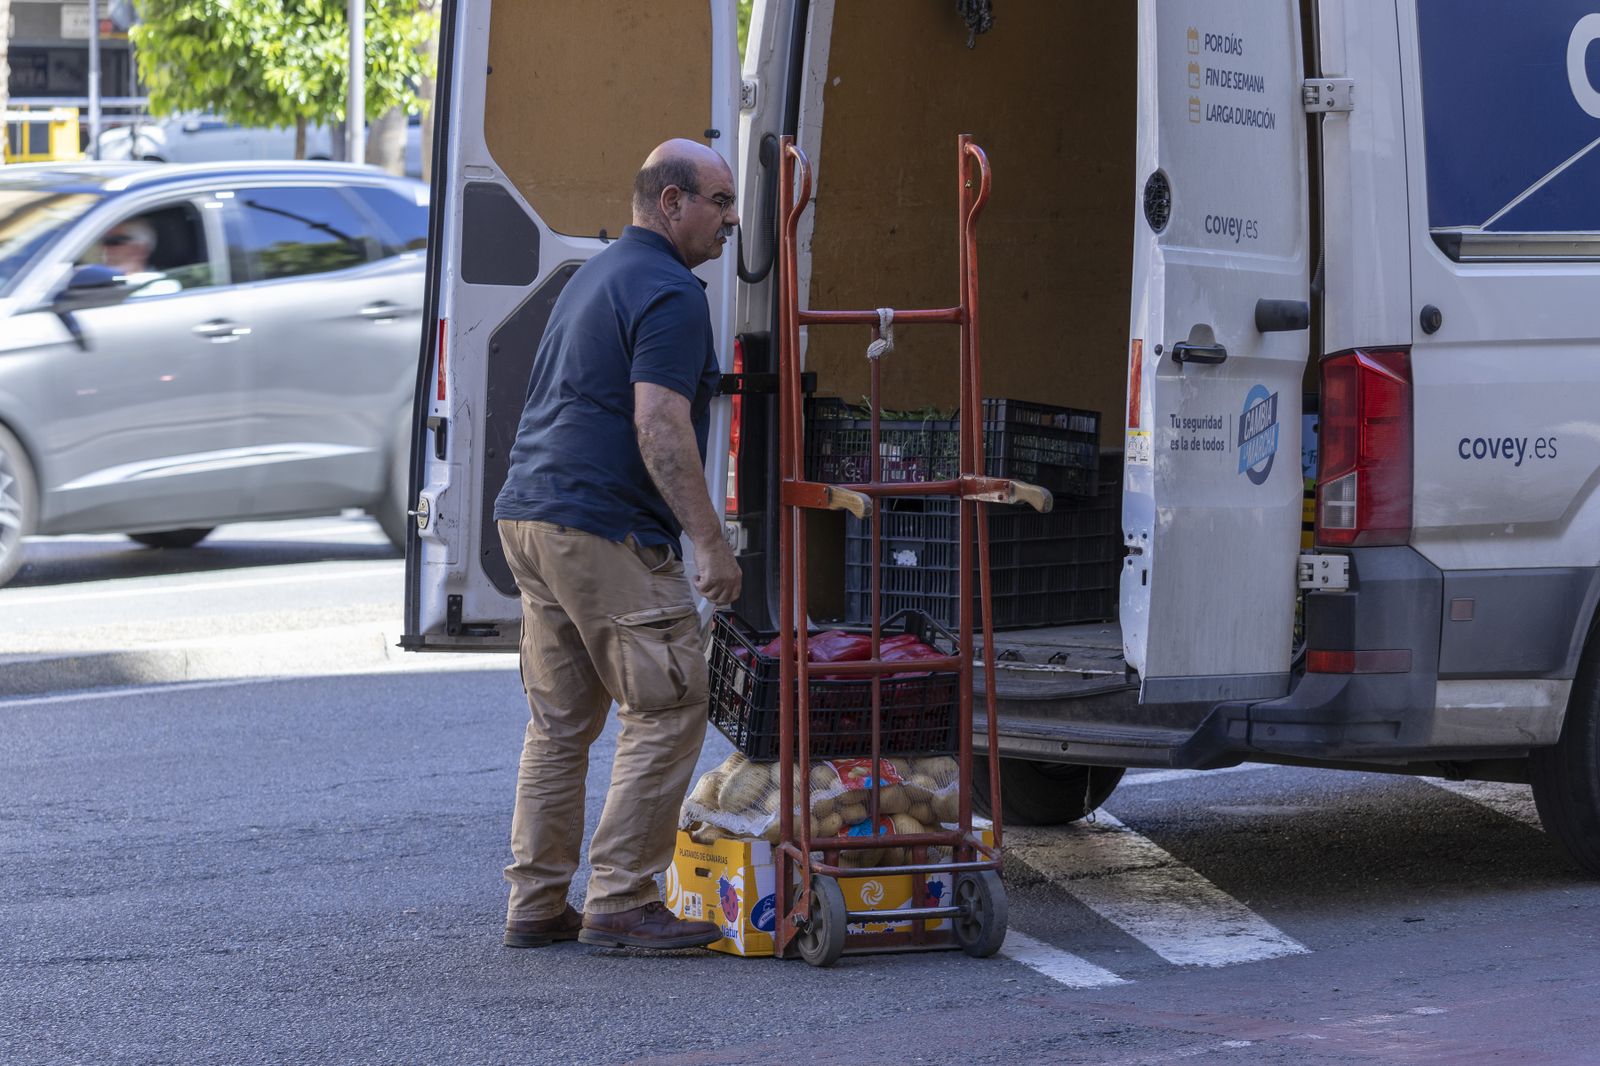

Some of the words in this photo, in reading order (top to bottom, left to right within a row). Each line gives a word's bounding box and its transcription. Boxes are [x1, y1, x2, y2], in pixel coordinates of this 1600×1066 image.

[1204, 33, 1223, 53] POR
[1224, 33, 1243, 56] DÍAS
[1205, 67, 1220, 87] FIN
[1220, 70, 1232, 89] DE
[1232, 71, 1265, 93] SEMANA
[1206, 104, 1234, 124] LARGA
[1235, 107, 1276, 130] DURACIÓN
[1205, 214, 1258, 243] covey.es
[1170, 413, 1181, 428] Tu
[1182, 414, 1223, 433] seguridad
[1243, 397, 1273, 441] CAMBIA
[1170, 438, 1179, 450] es
[1180, 436, 1189, 450] la
[1190, 437, 1201, 451] de
[1202, 437, 1225, 451] todos
[1458, 437, 1557, 467] covey.es
